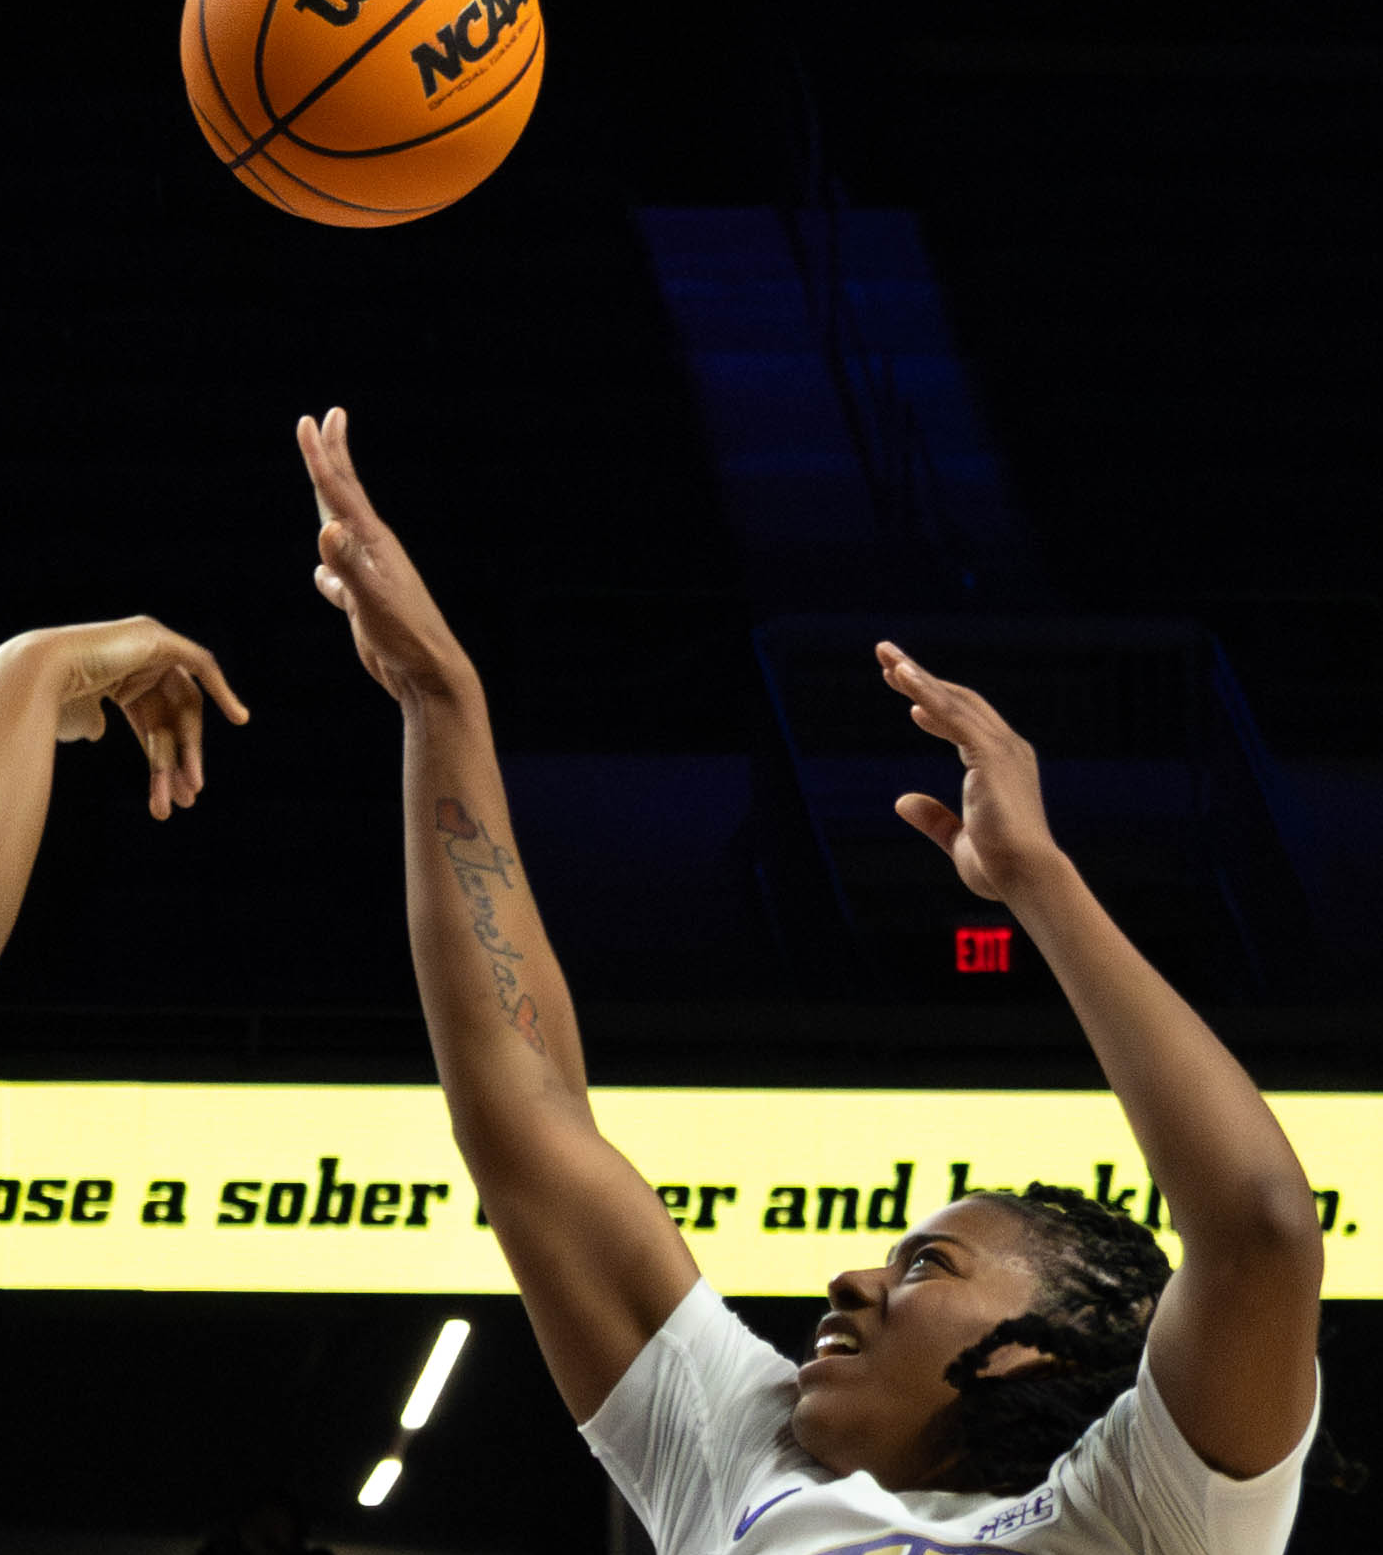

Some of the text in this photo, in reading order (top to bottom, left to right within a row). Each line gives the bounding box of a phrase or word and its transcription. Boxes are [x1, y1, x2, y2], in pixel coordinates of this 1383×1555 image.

[141, 1180, 189, 1227] a
[217, 1156, 450, 1228] sober
[763, 1162, 915, 1231] and
